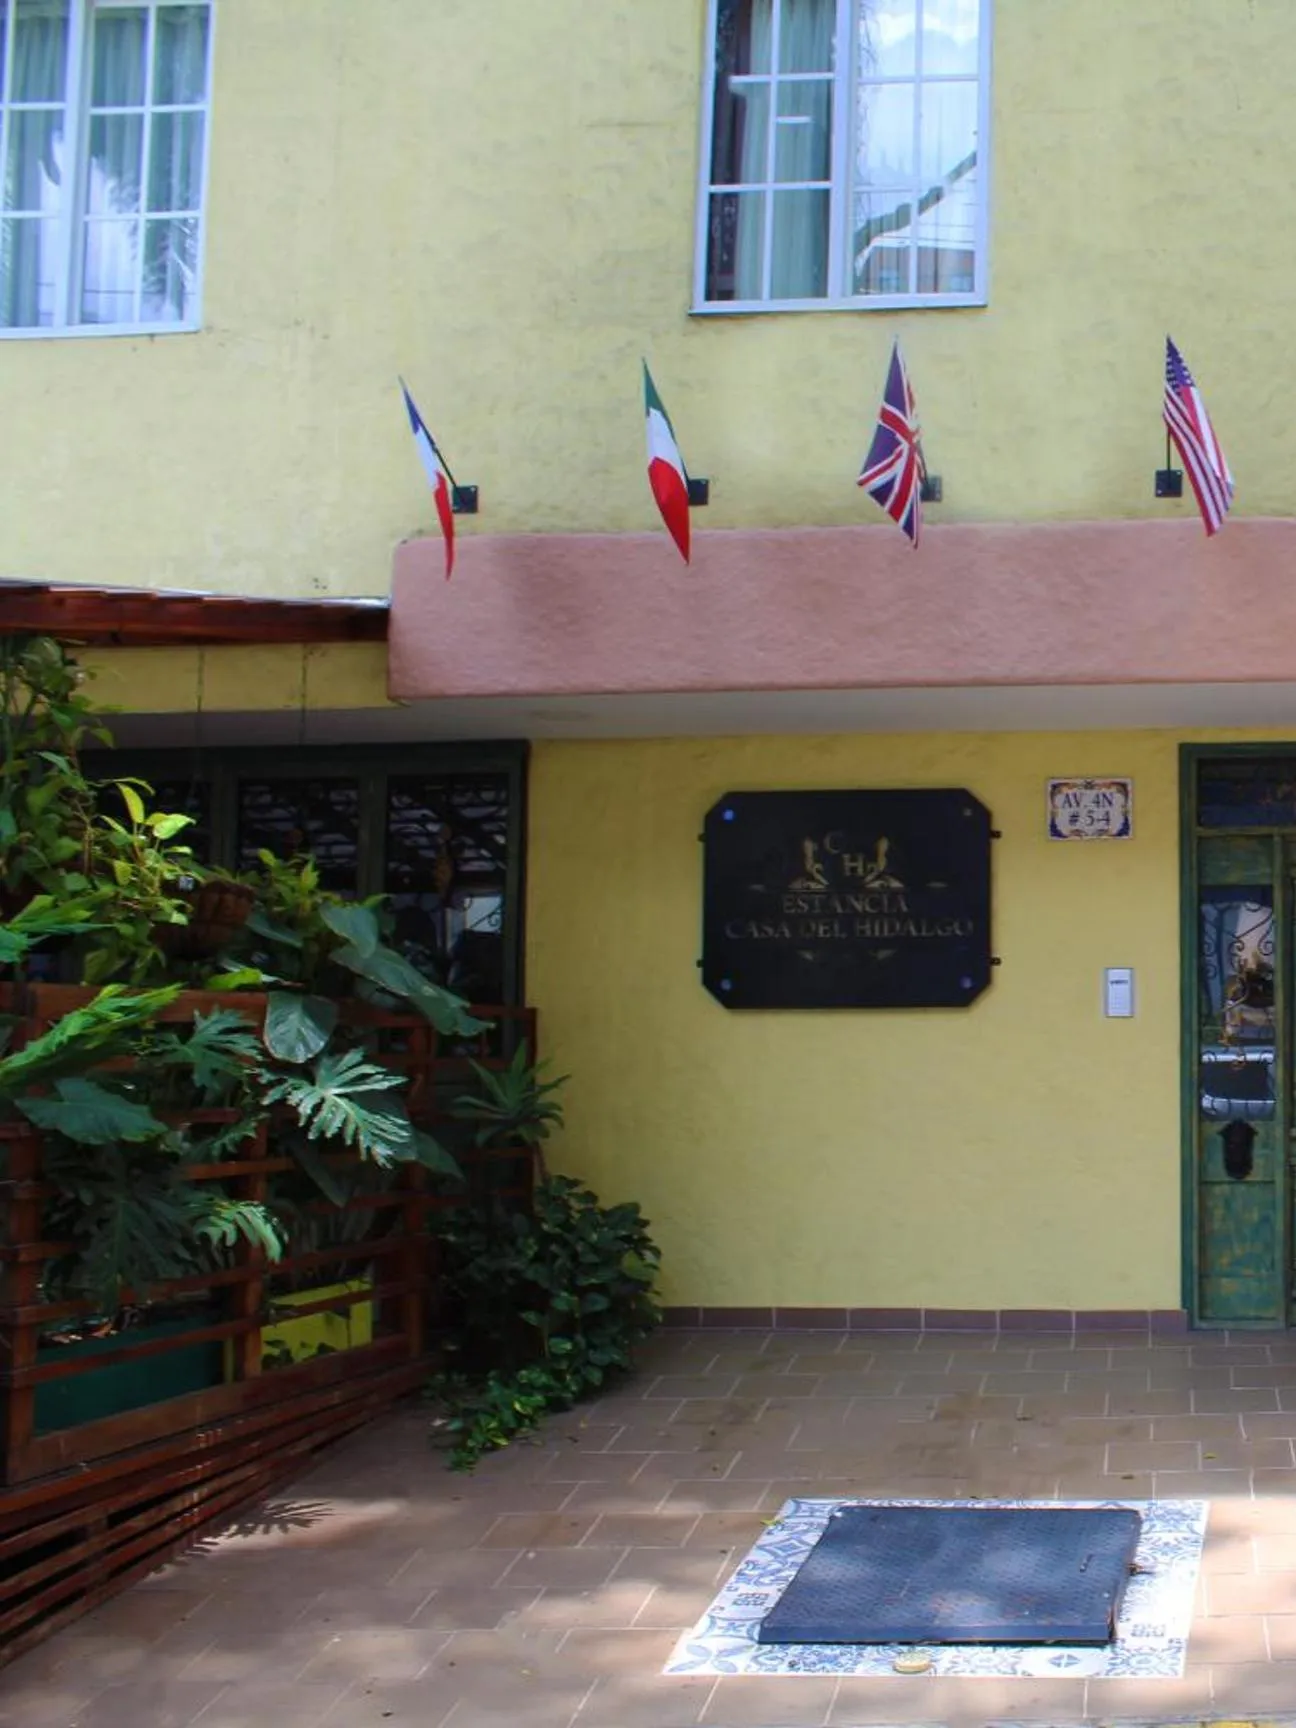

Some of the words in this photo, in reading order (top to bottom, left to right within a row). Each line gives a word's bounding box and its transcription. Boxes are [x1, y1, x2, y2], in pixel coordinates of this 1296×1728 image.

[782, 893, 909, 914] ESTANCIA
[725, 917, 791, 939] CASA
[800, 917, 848, 938] DEL
[854, 917, 974, 938] HIDALGO
